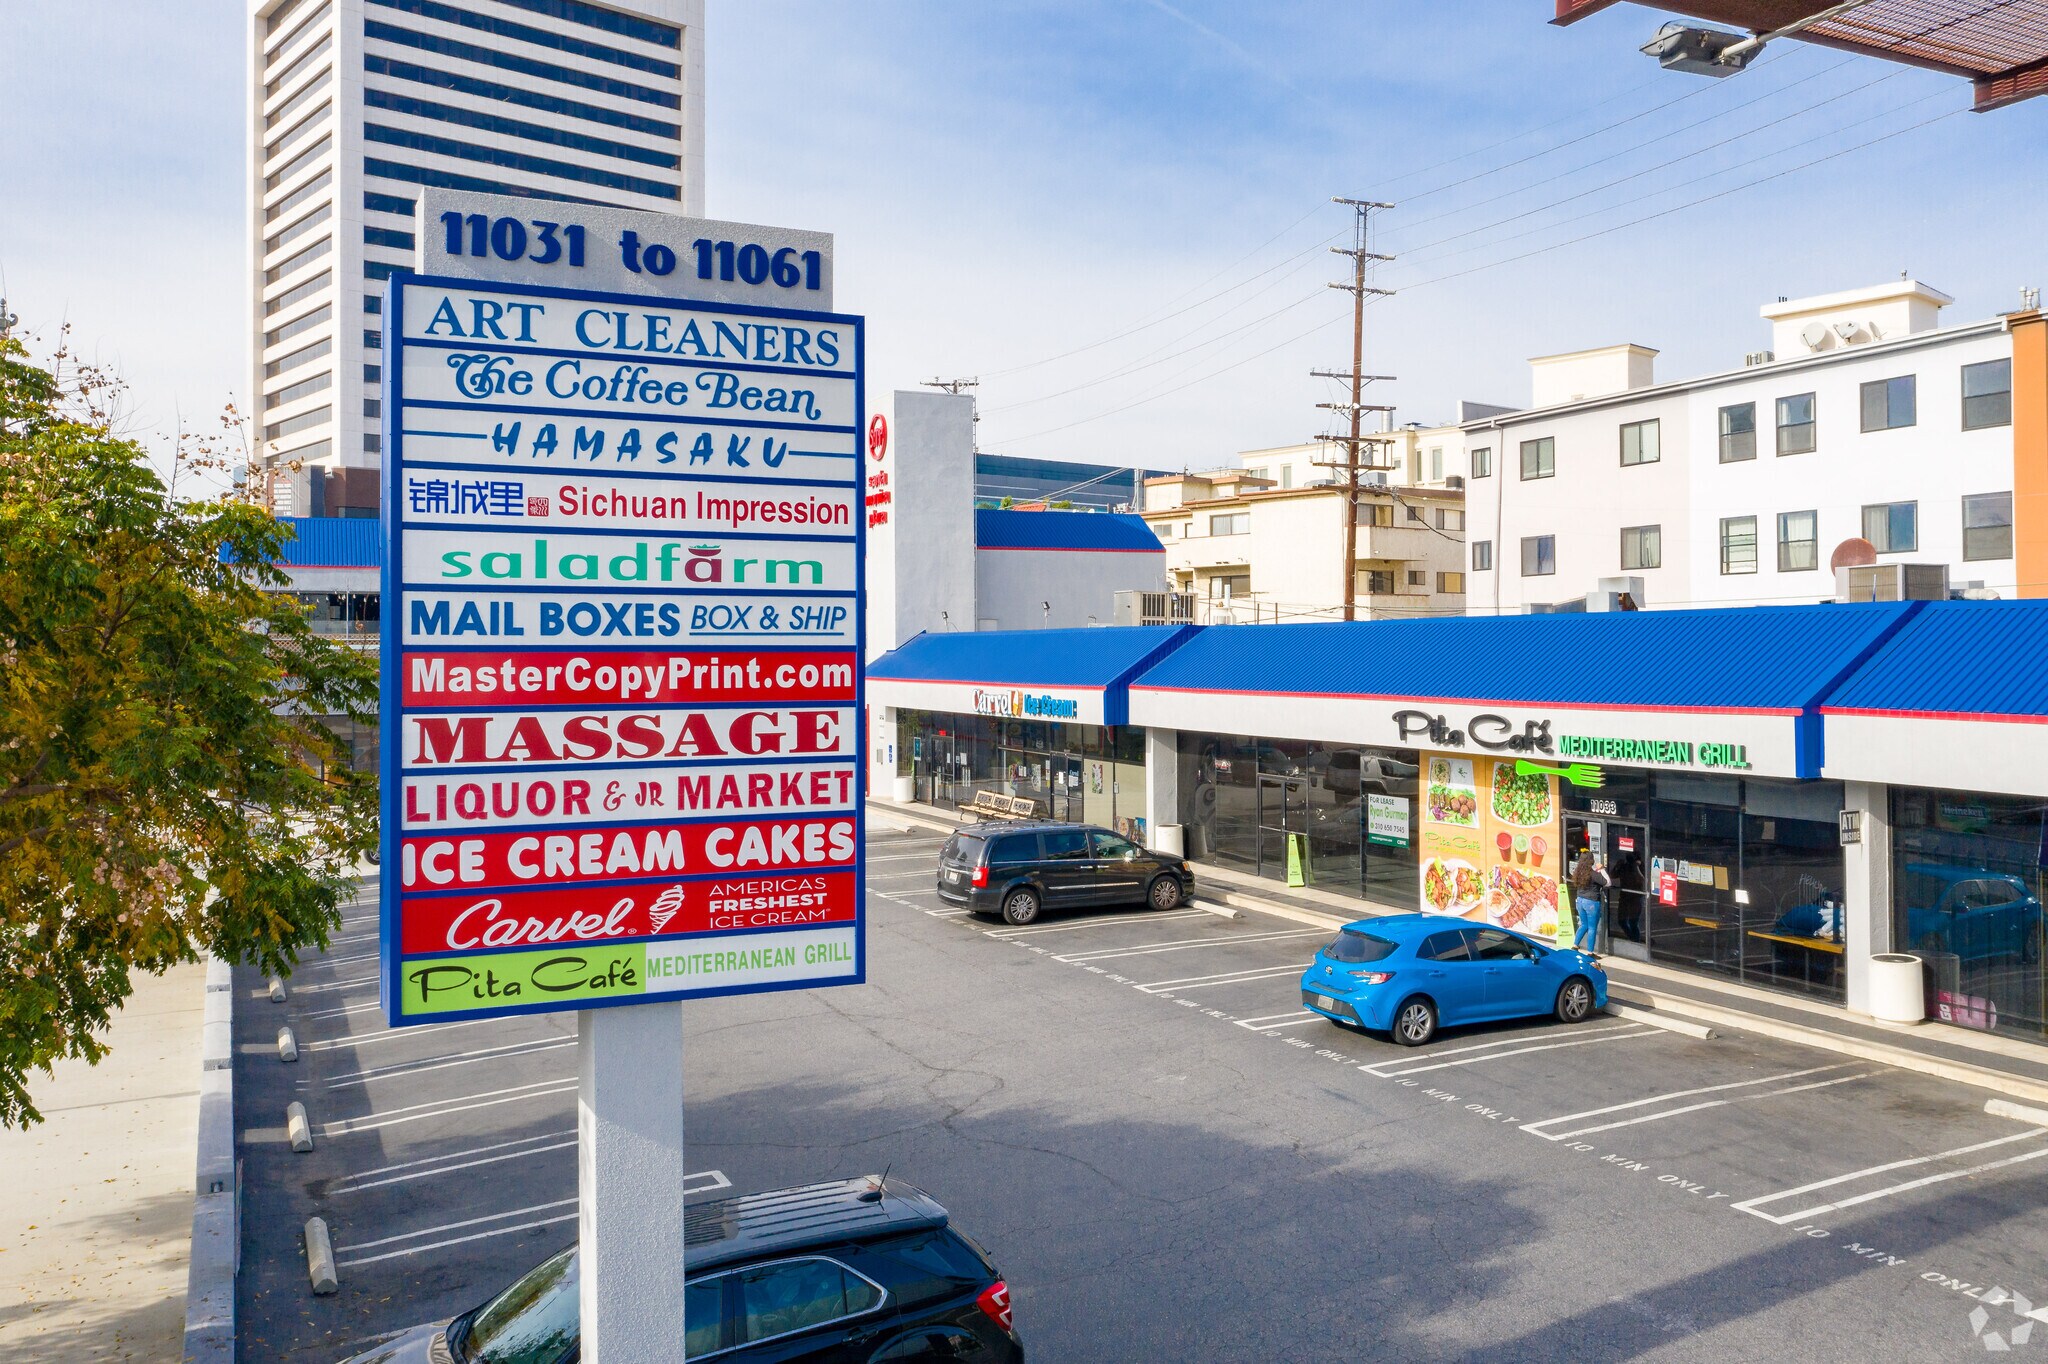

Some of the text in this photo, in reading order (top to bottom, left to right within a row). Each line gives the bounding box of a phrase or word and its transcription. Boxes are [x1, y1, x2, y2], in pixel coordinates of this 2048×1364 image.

[441, 211, 821, 290] 11031 to 11061
[425, 296, 840, 367] ART CLEANERS
[447, 353, 822, 420] The Coffee Bean
[491, 420, 789, 469] HAMASAKU
[409, 477, 524, 516] 锦城里
[559, 484, 687, 520] Sichuan
[697, 490, 849, 529] Impression
[441, 538, 824, 585] saladfarm
[410, 600, 848, 637] MAIL BOXES BOX & SHIP
[410, 657, 853, 699] MasterCopyPrint.com
[972, 688, 1013, 716] Carvel
[412, 710, 841, 764] MASSAGE
[1392, 709, 1554, 756] Pita Café
[1559, 735, 1750, 769] MEDITERRANEAN GRILL
[406, 778, 592, 823] LIQUOR
[602, 780, 628, 811] &
[677, 770, 854, 811] MARKET
[1370, 796, 1395, 806] FOR LEASE
[1591, 799, 1617, 815] 11033
[1944, 806, 1983, 818] Heineken
[403, 821, 855, 887] ICE CREAM CAKES
[1842, 831, 1861, 843] INSIDE
[1653, 858, 1661, 869] A
[709, 877, 827, 897] AMERICAS
[709, 893, 828, 913] FRESHEST
[710, 914, 745, 929] ICE
[410, 956, 638, 1003] Pita Café
[647, 941, 853, 979] MEDITERRANEAN GRILL
[1282, 1037, 1315, 1050] MIN
[1315, 1049, 1361, 1065] ONLY
[1394, 1078, 1521, 1125] 10 MIN ONLY
[1564, 1140, 1730, 1200] 10 MIN ONLY
[1794, 1224, 1831, 1238] 10
[1842, 1242, 1907, 1267] MIN
